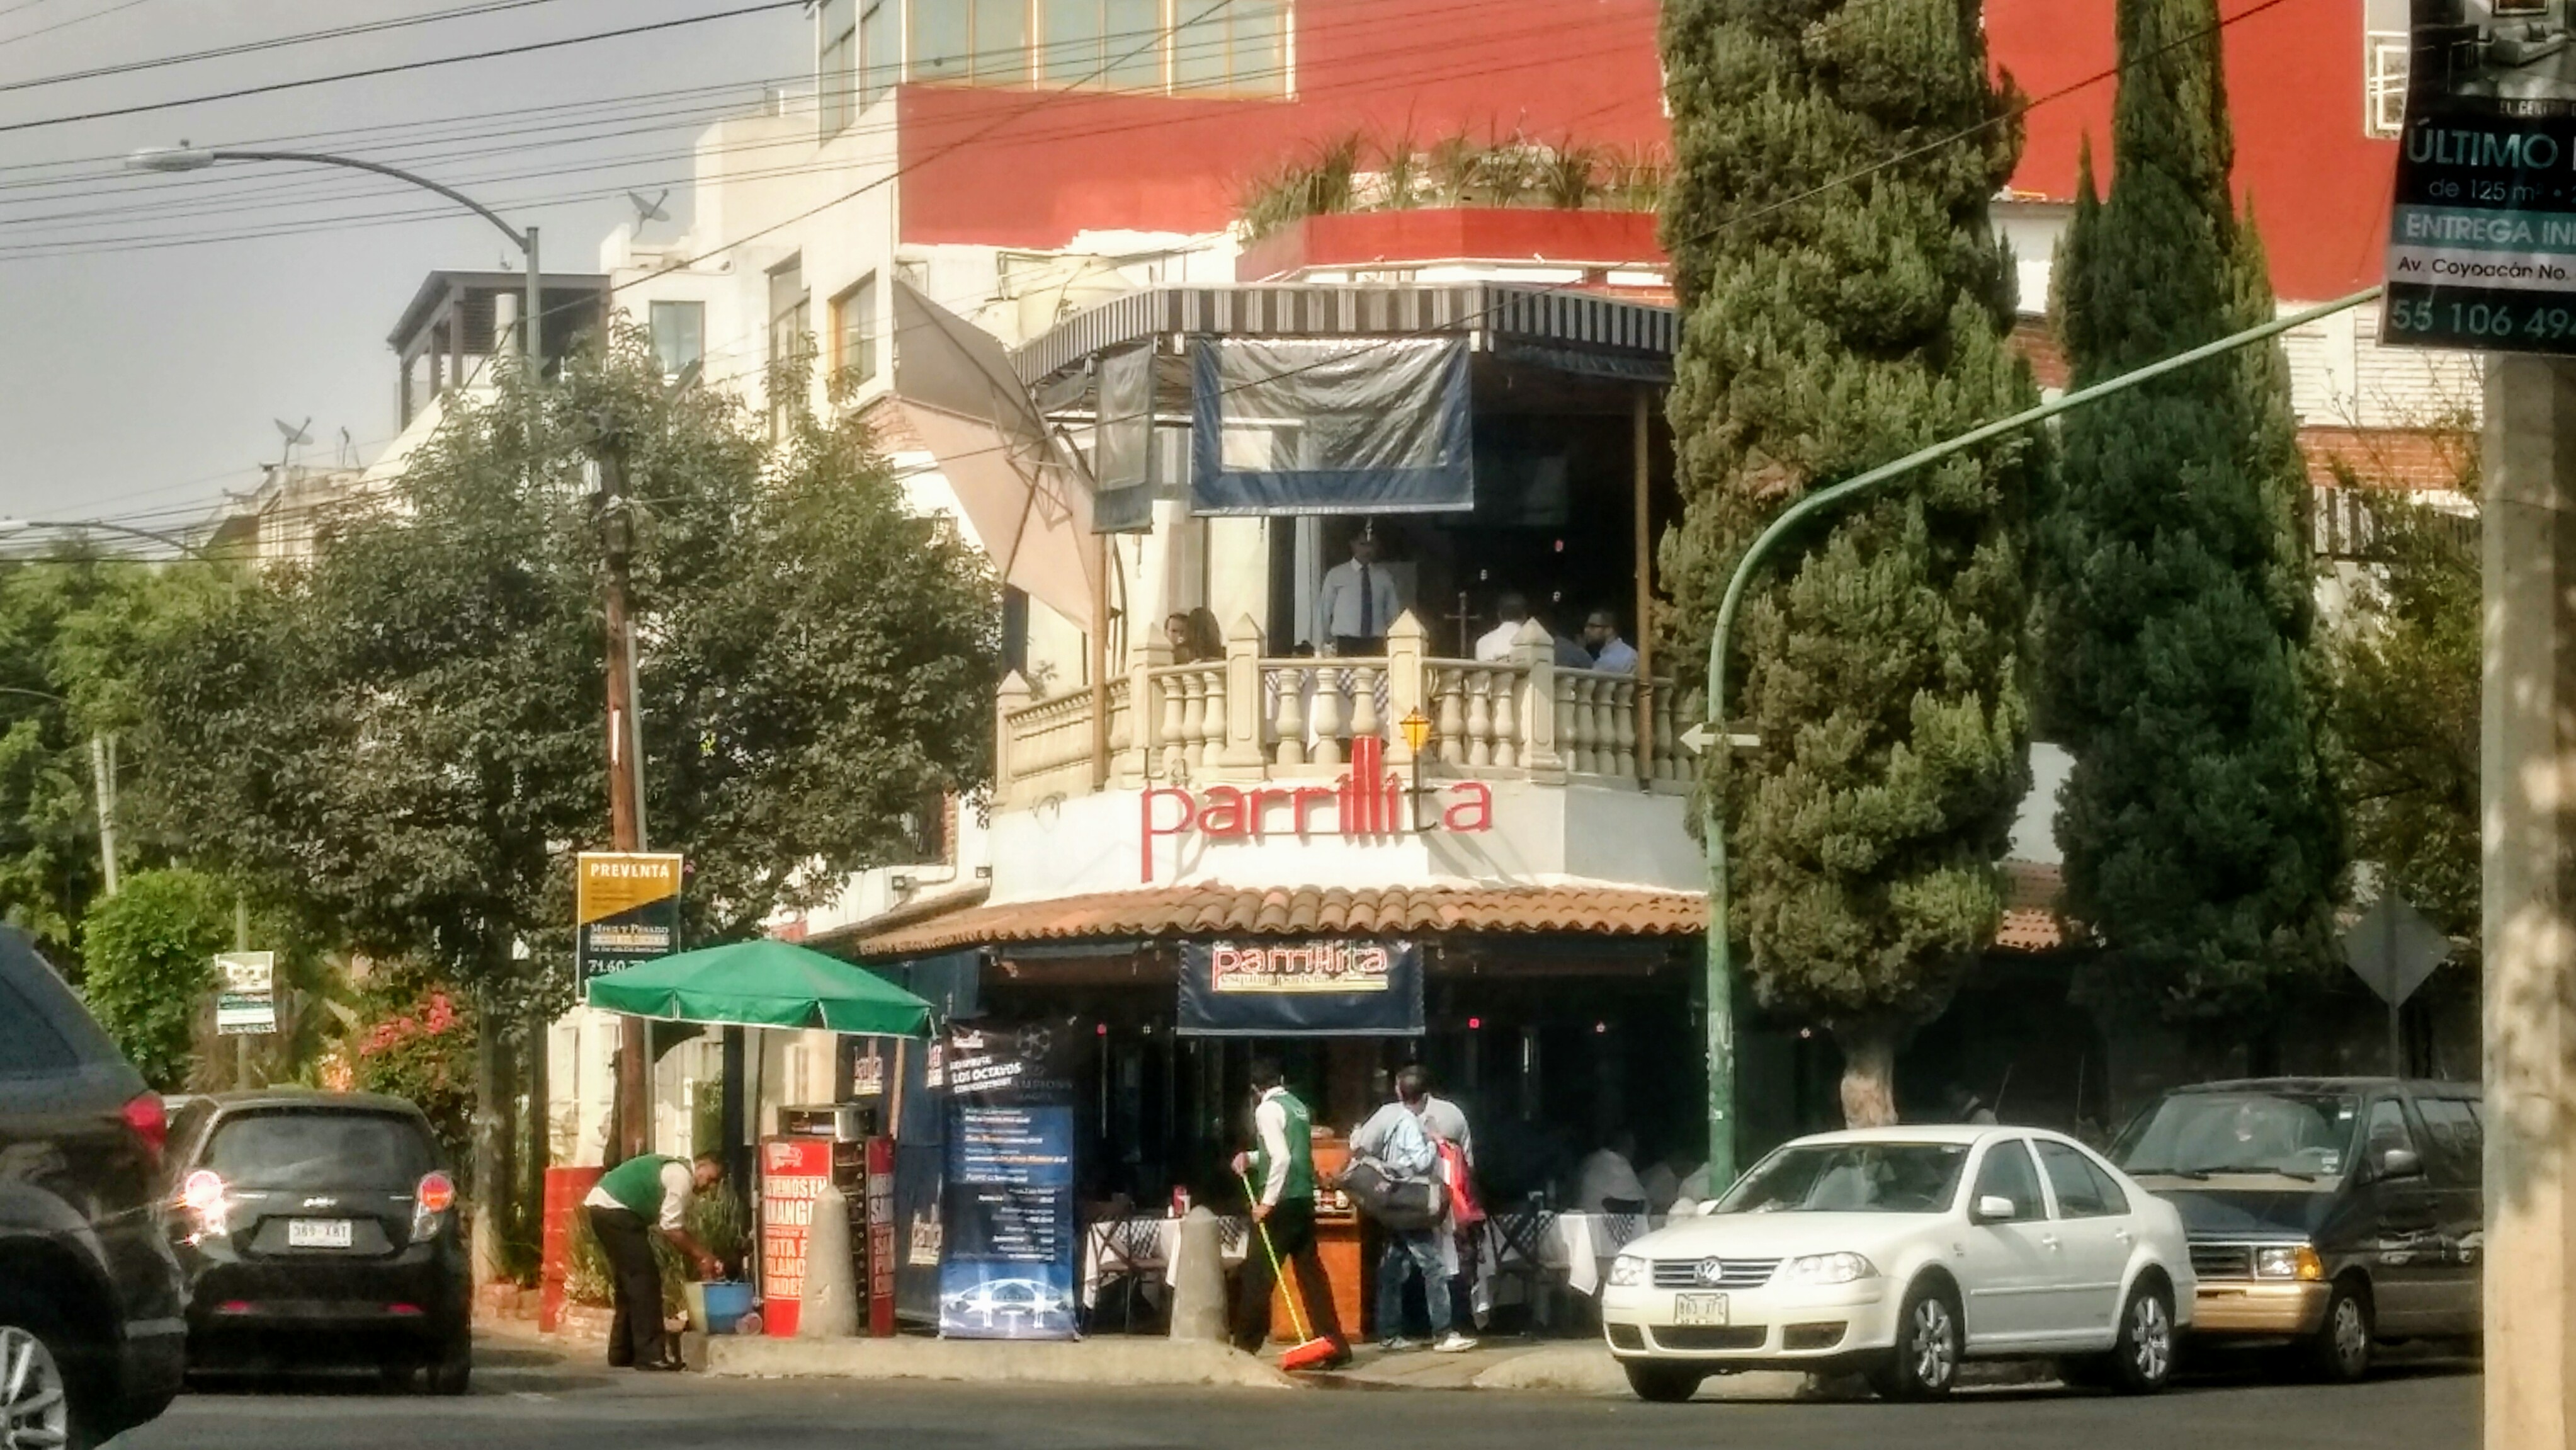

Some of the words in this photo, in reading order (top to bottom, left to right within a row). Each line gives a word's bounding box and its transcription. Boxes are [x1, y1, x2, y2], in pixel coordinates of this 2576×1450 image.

[2407, 118, 2558, 169] ÚLTIMO
[2429, 178, 2460, 198] de
[2470, 179, 2506, 201] 125
[2406, 213, 2533, 244] ENTREGA
[2542, 220, 2576, 246] IN
[2398, 256, 2425, 273] Av.
[2432, 258, 2533, 280] Coyoacán
[2393, 298, 2434, 331] 55
[2451, 303, 2512, 336] 106
[1141, 735, 1492, 883] parrillita
[591, 862, 670, 879] PREVENTA
[1213, 940, 1388, 991] parrillita
[972, 1062, 1022, 1081] OCTAVOS
